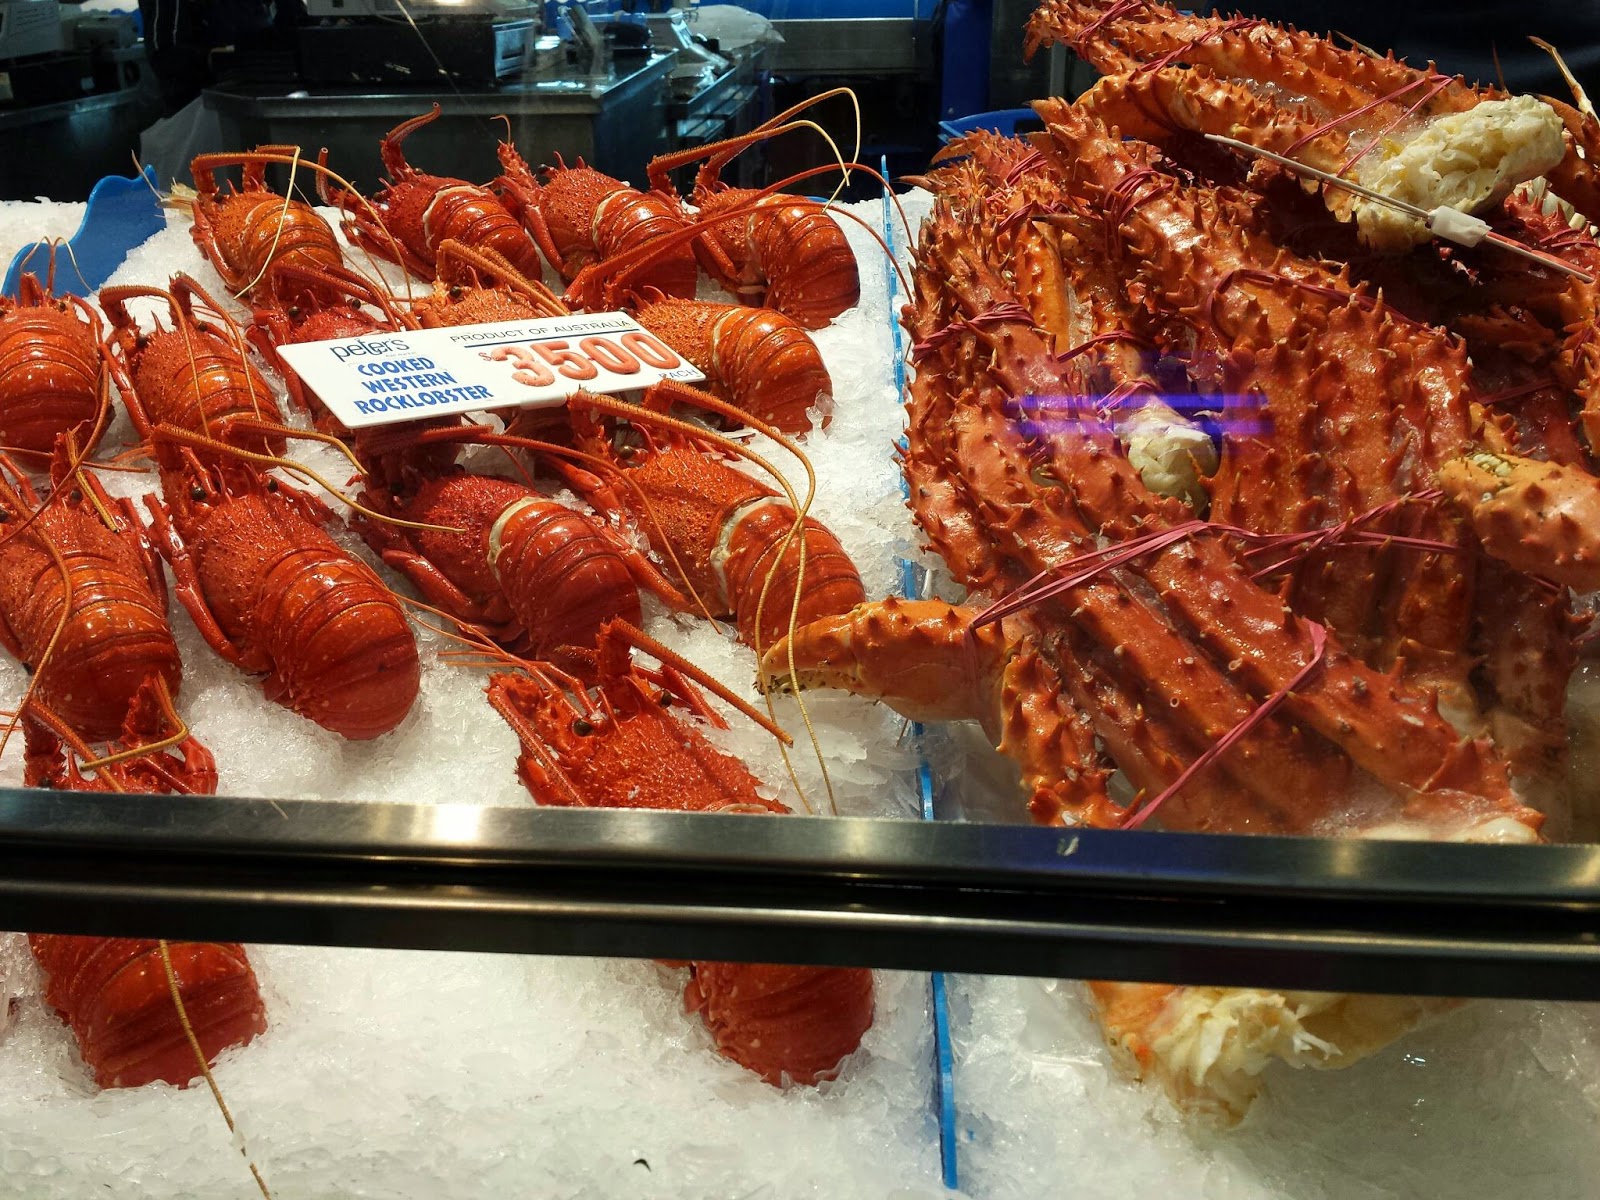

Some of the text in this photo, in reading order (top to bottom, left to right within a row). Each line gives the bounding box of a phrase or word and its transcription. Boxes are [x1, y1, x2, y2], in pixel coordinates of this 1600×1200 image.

[449, 319, 631, 343] PRODUCT OF AUSTRALIA
[357, 357, 435, 376] COOKED
[361, 371, 458, 394] WESTERN
[353, 385, 494, 414] ROCKLOBSTER
